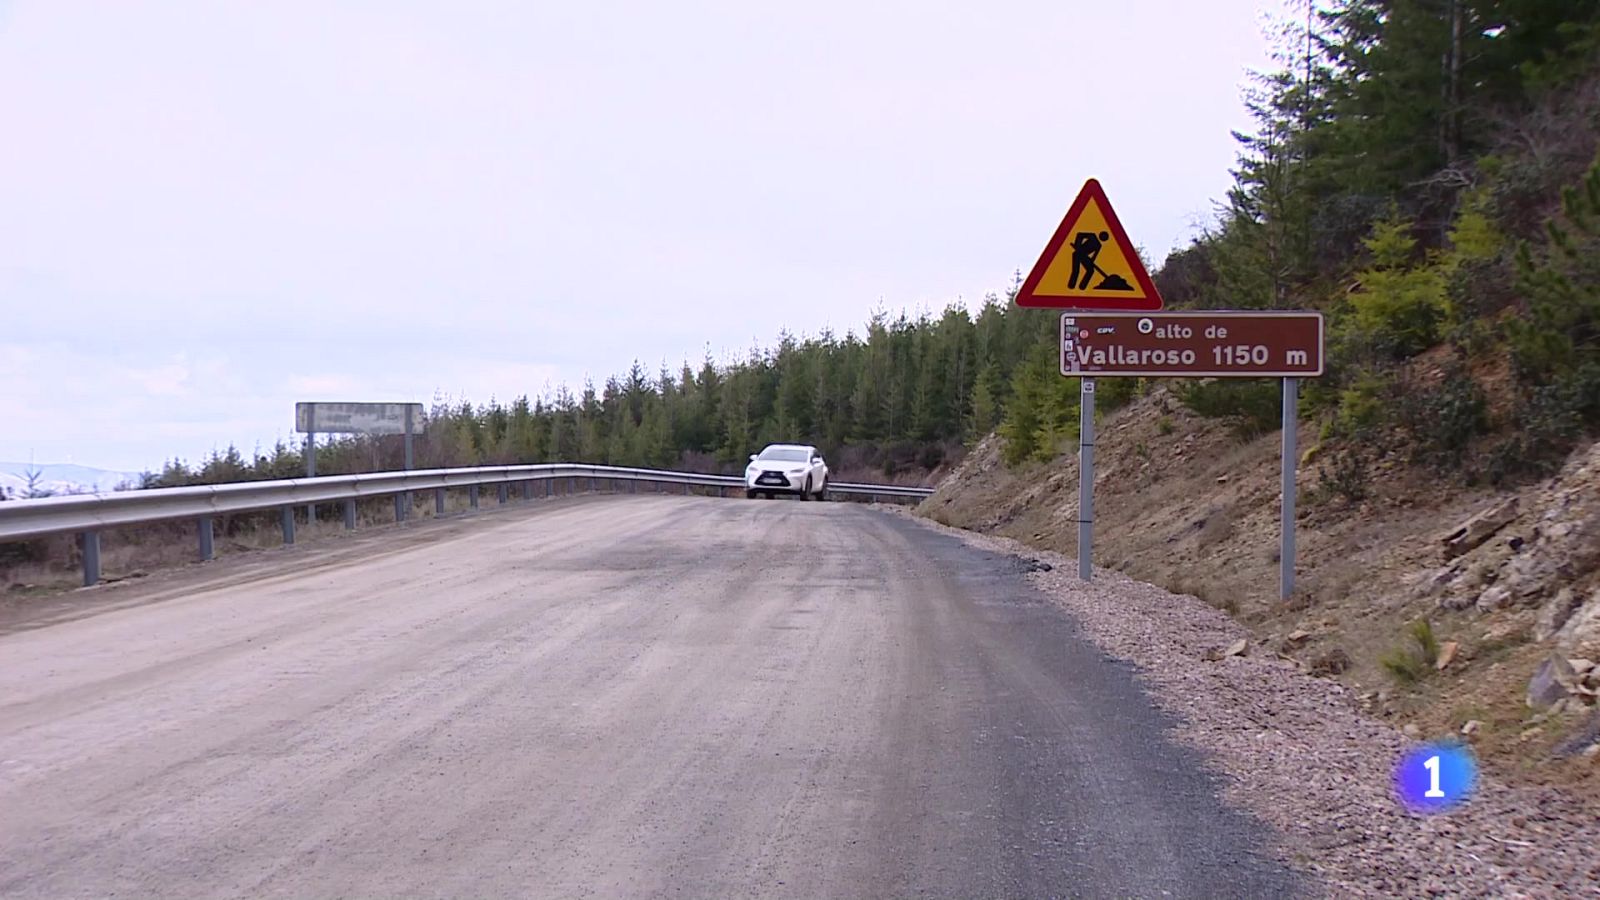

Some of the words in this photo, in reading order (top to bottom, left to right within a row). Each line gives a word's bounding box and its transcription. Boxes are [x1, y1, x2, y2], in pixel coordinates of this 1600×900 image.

[1155, 324, 1192, 339] alto
[1204, 325, 1227, 339] de
[1077, 345, 1196, 365] Vallaroso
[1213, 345, 1269, 365] 1150
[1286, 350, 1307, 365] m
